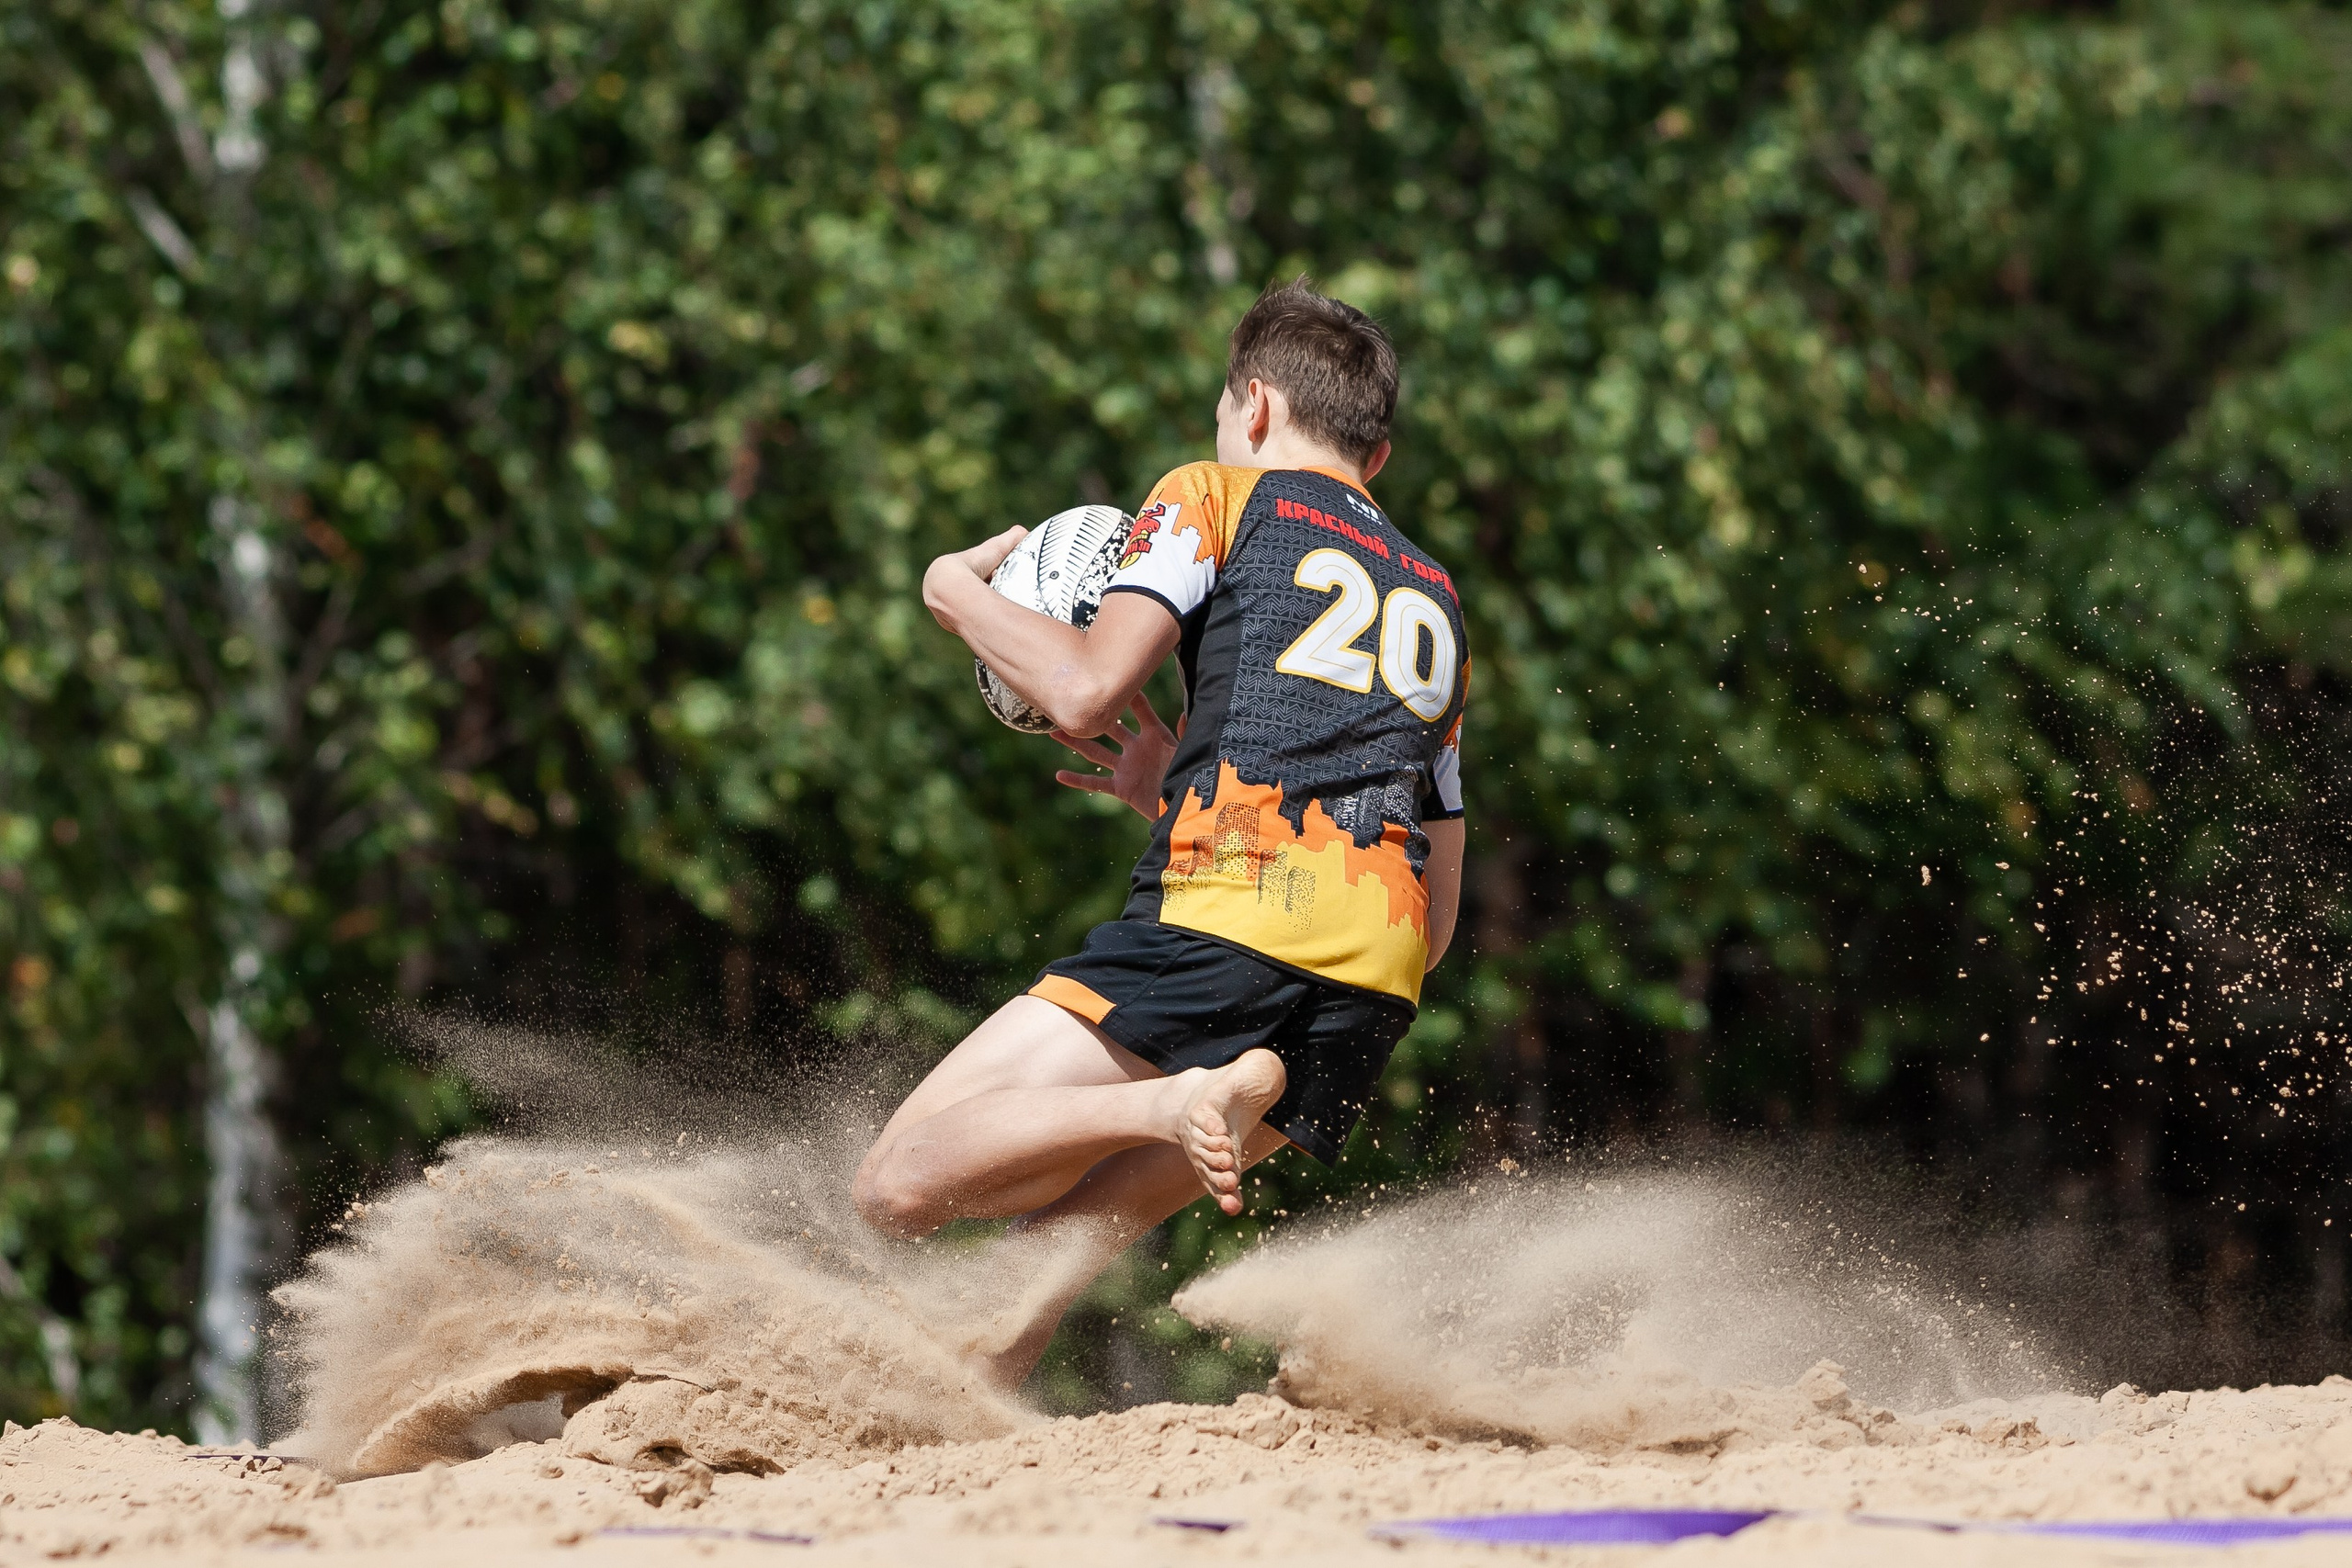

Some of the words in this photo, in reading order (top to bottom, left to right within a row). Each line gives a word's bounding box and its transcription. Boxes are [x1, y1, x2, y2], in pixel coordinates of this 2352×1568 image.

[1276, 498, 1390, 559] КРАСНЫЙ
[1399, 553, 1460, 608] ГОРО
[1275, 547, 1457, 723] 20
